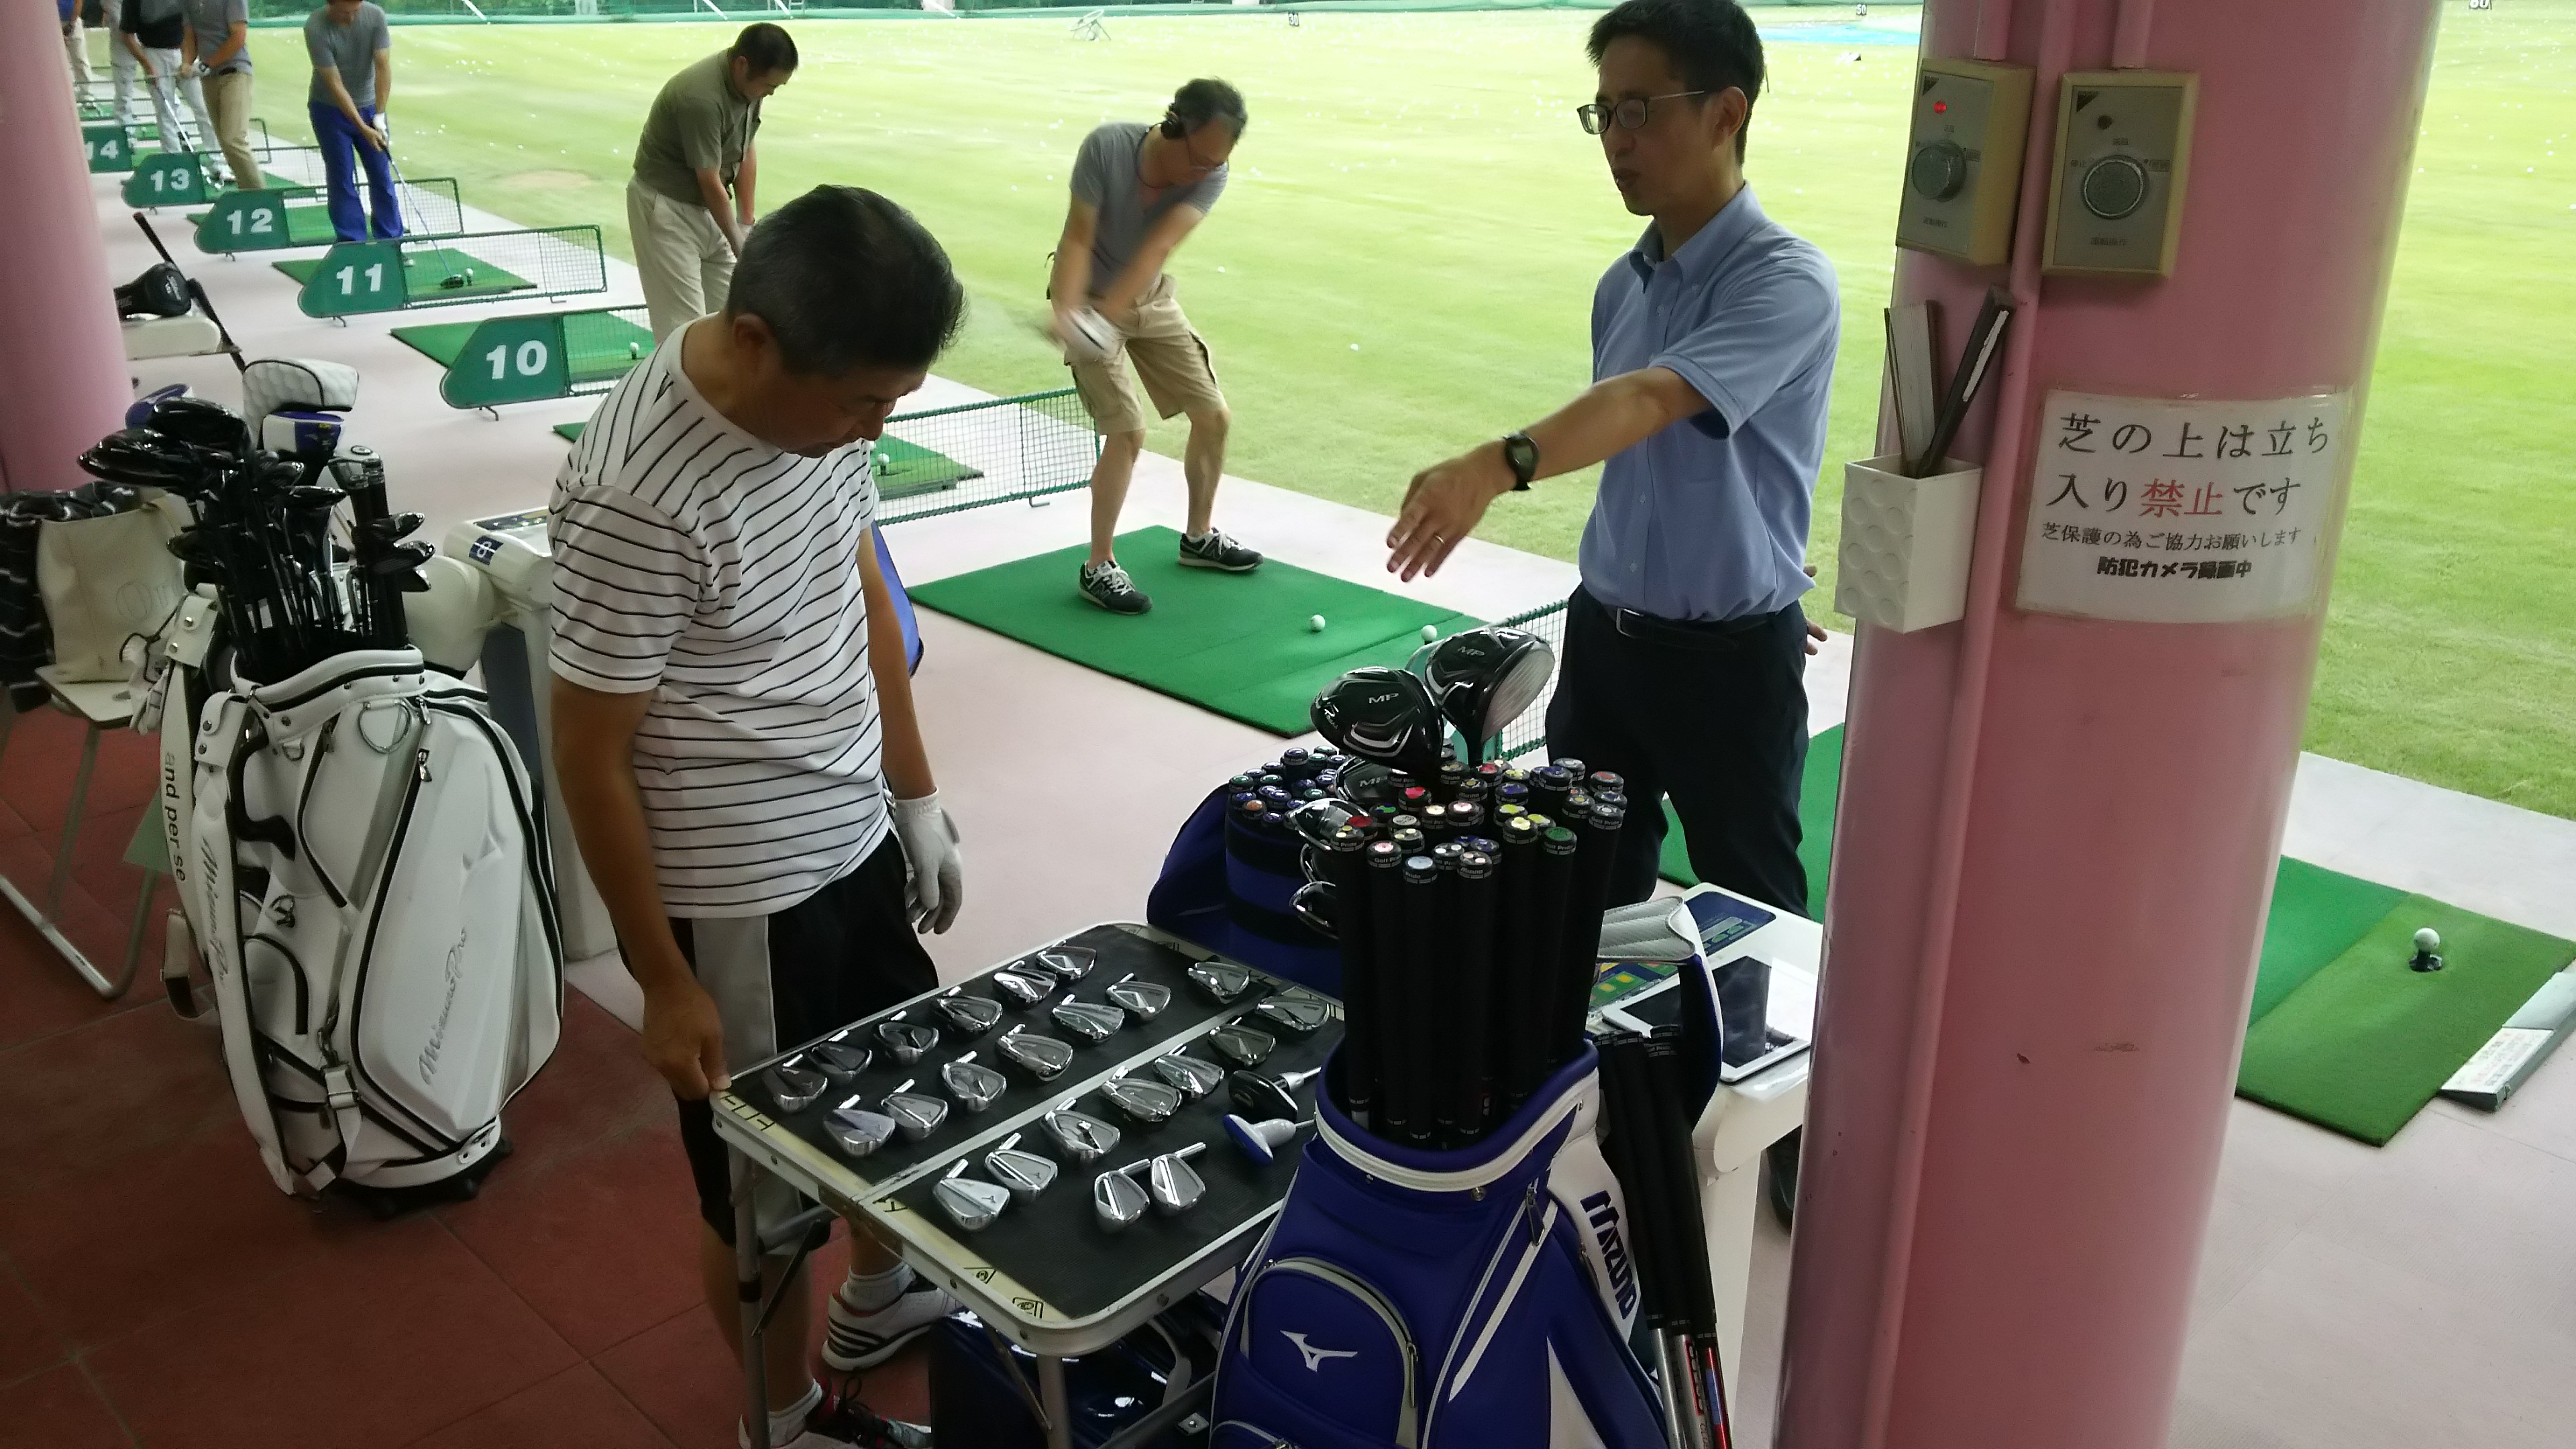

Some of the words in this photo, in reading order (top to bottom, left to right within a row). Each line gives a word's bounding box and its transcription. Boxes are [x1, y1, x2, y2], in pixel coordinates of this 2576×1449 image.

[1289, 13, 1299, 25] 30
[1856, 4, 1866, 15] 50
[150, 168, 191, 192] 13
[226, 207, 273, 235] 12
[336, 263, 382, 295] 11
[486, 339, 548, 380] 10
[2058, 412, 2328, 459] 芝の上は立ち
[2046, 472, 2302, 519] 入り禁止です
[1457, 646, 1485, 657] MP
[1368, 692, 1399, 704] MP
[164, 751, 180, 800] and
[1360, 775, 1389, 788] MP
[165, 805, 180, 850] per
[173, 853, 186, 882] se
[1580, 1189, 1638, 1320] MIZUNO
